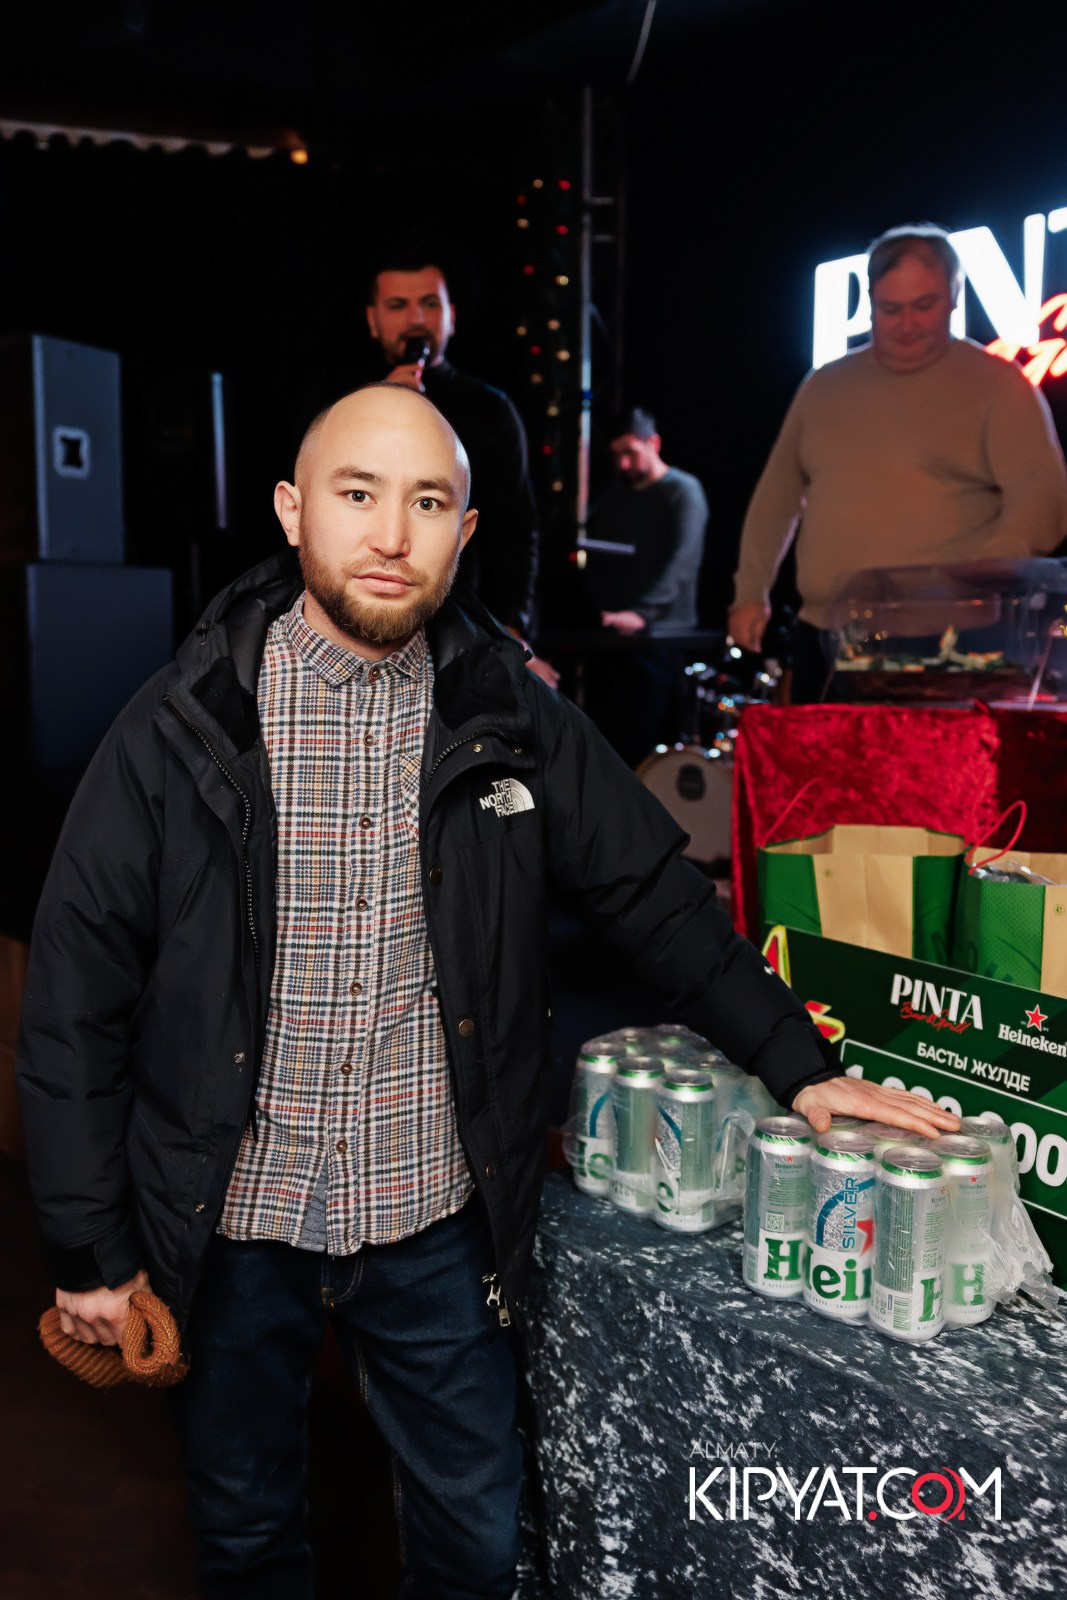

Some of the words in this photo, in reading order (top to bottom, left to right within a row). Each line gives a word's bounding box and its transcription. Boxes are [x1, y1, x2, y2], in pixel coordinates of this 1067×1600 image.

[479, 790, 513, 810] NORTH
[491, 779, 511, 793] THE
[494, 801, 515, 818] FACE
[890, 973, 984, 1031] PINTA
[916, 1041, 968, 1072] БАСТЫ
[998, 1023, 1067, 1059] Heineken
[842, 1176, 860, 1250] SILVER
